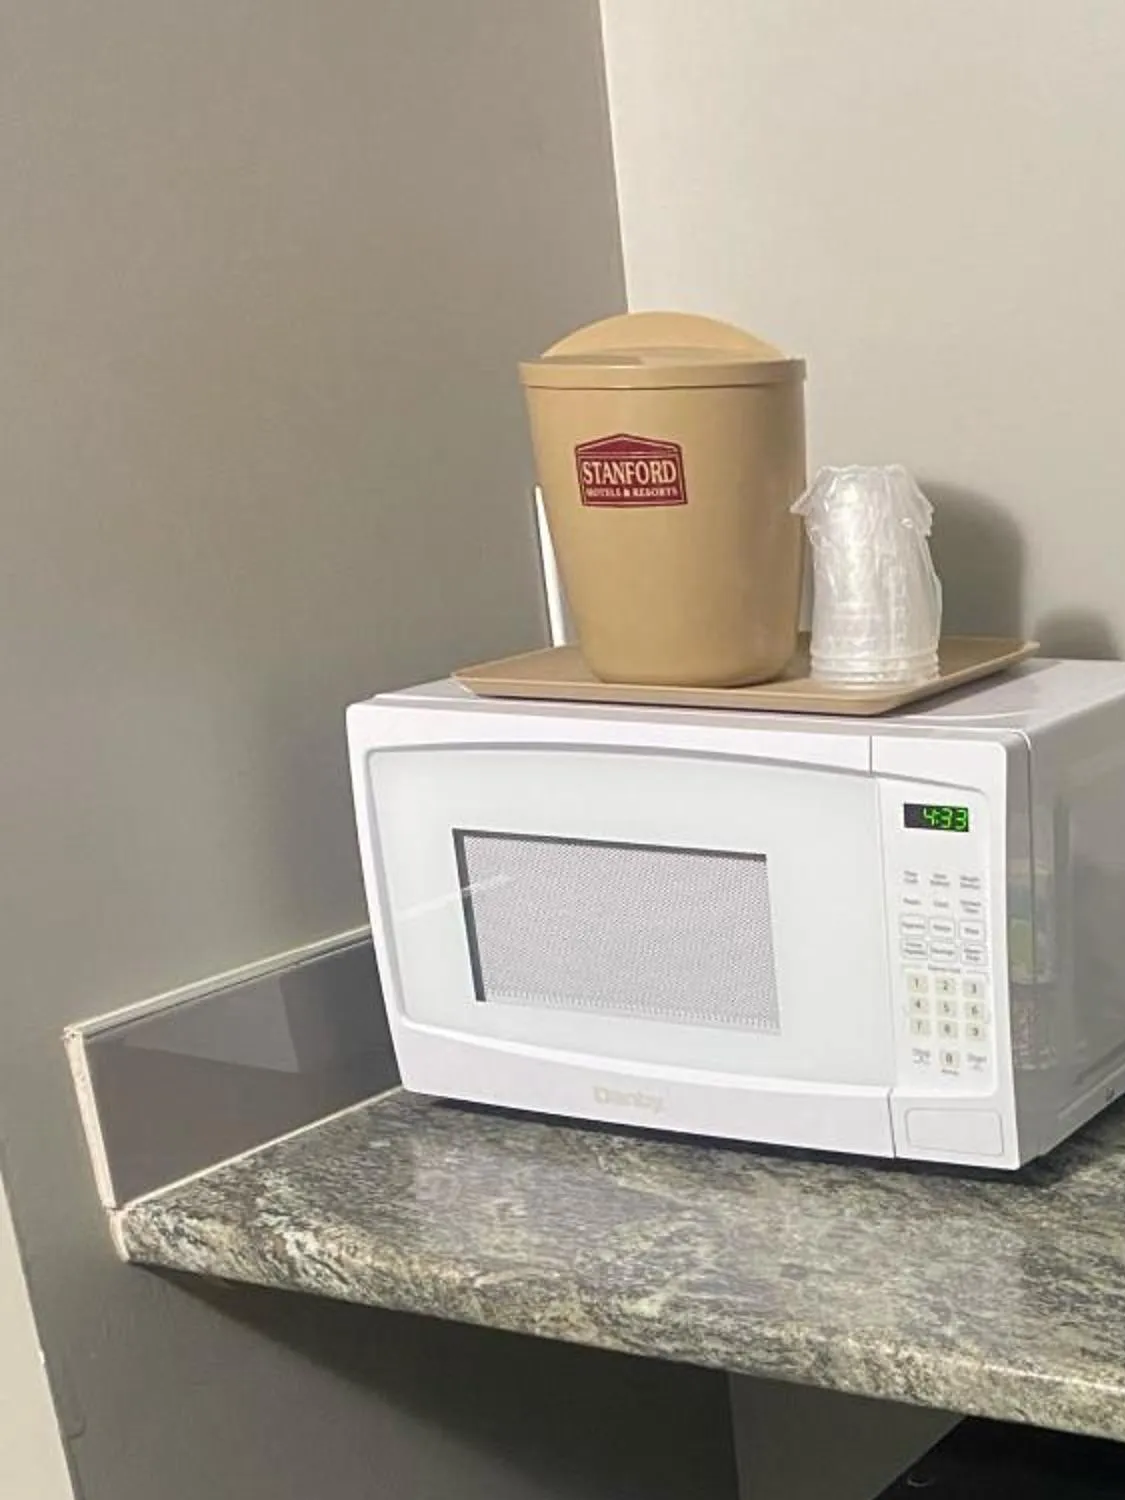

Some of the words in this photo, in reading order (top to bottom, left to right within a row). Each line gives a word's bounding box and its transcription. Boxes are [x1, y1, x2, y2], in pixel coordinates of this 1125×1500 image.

[582, 460, 678, 485] STANFORD
[632, 486, 679, 497] RESORTS
[923, 806, 967, 830] 4:33
